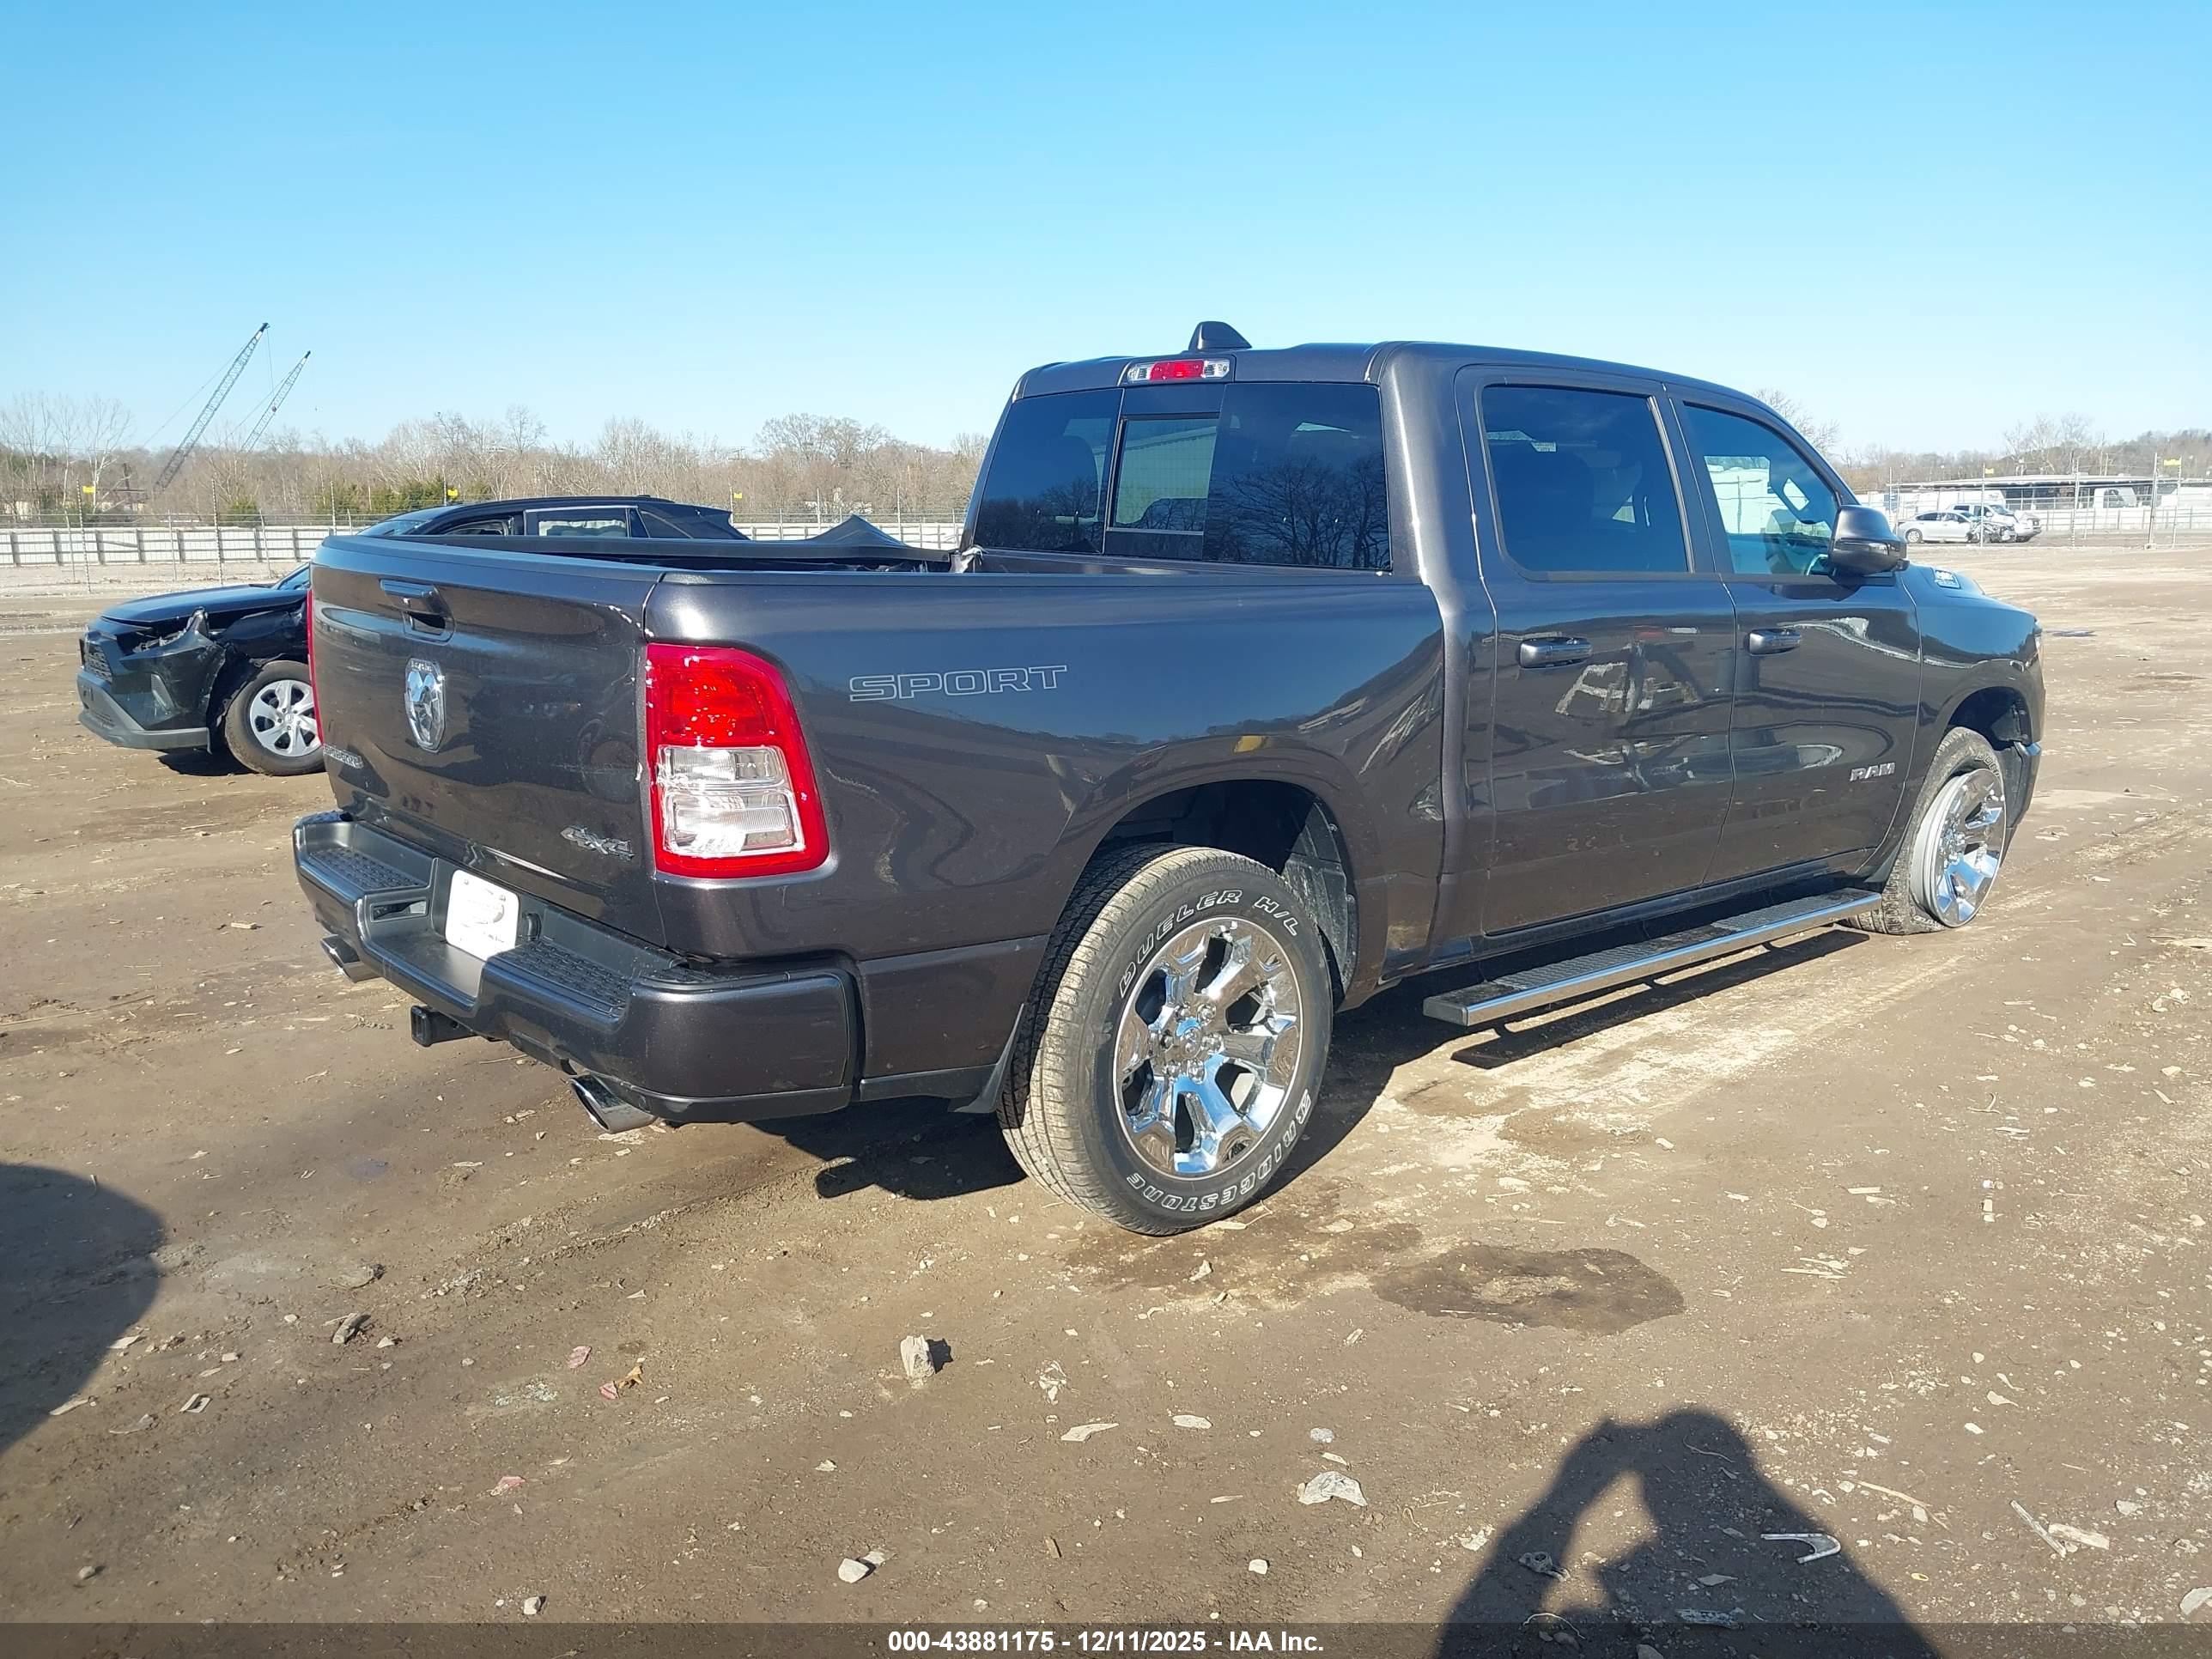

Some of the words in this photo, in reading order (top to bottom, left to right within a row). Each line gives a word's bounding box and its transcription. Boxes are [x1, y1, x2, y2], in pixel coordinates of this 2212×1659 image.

[849, 665, 1067, 702] SPORT
[1850, 762, 1896, 782] RAM
[1119, 890, 1243, 999] DUELER
[1255, 896, 1300, 937] H/L
[1126, 1088, 1312, 1213] BRIDGESTONE
